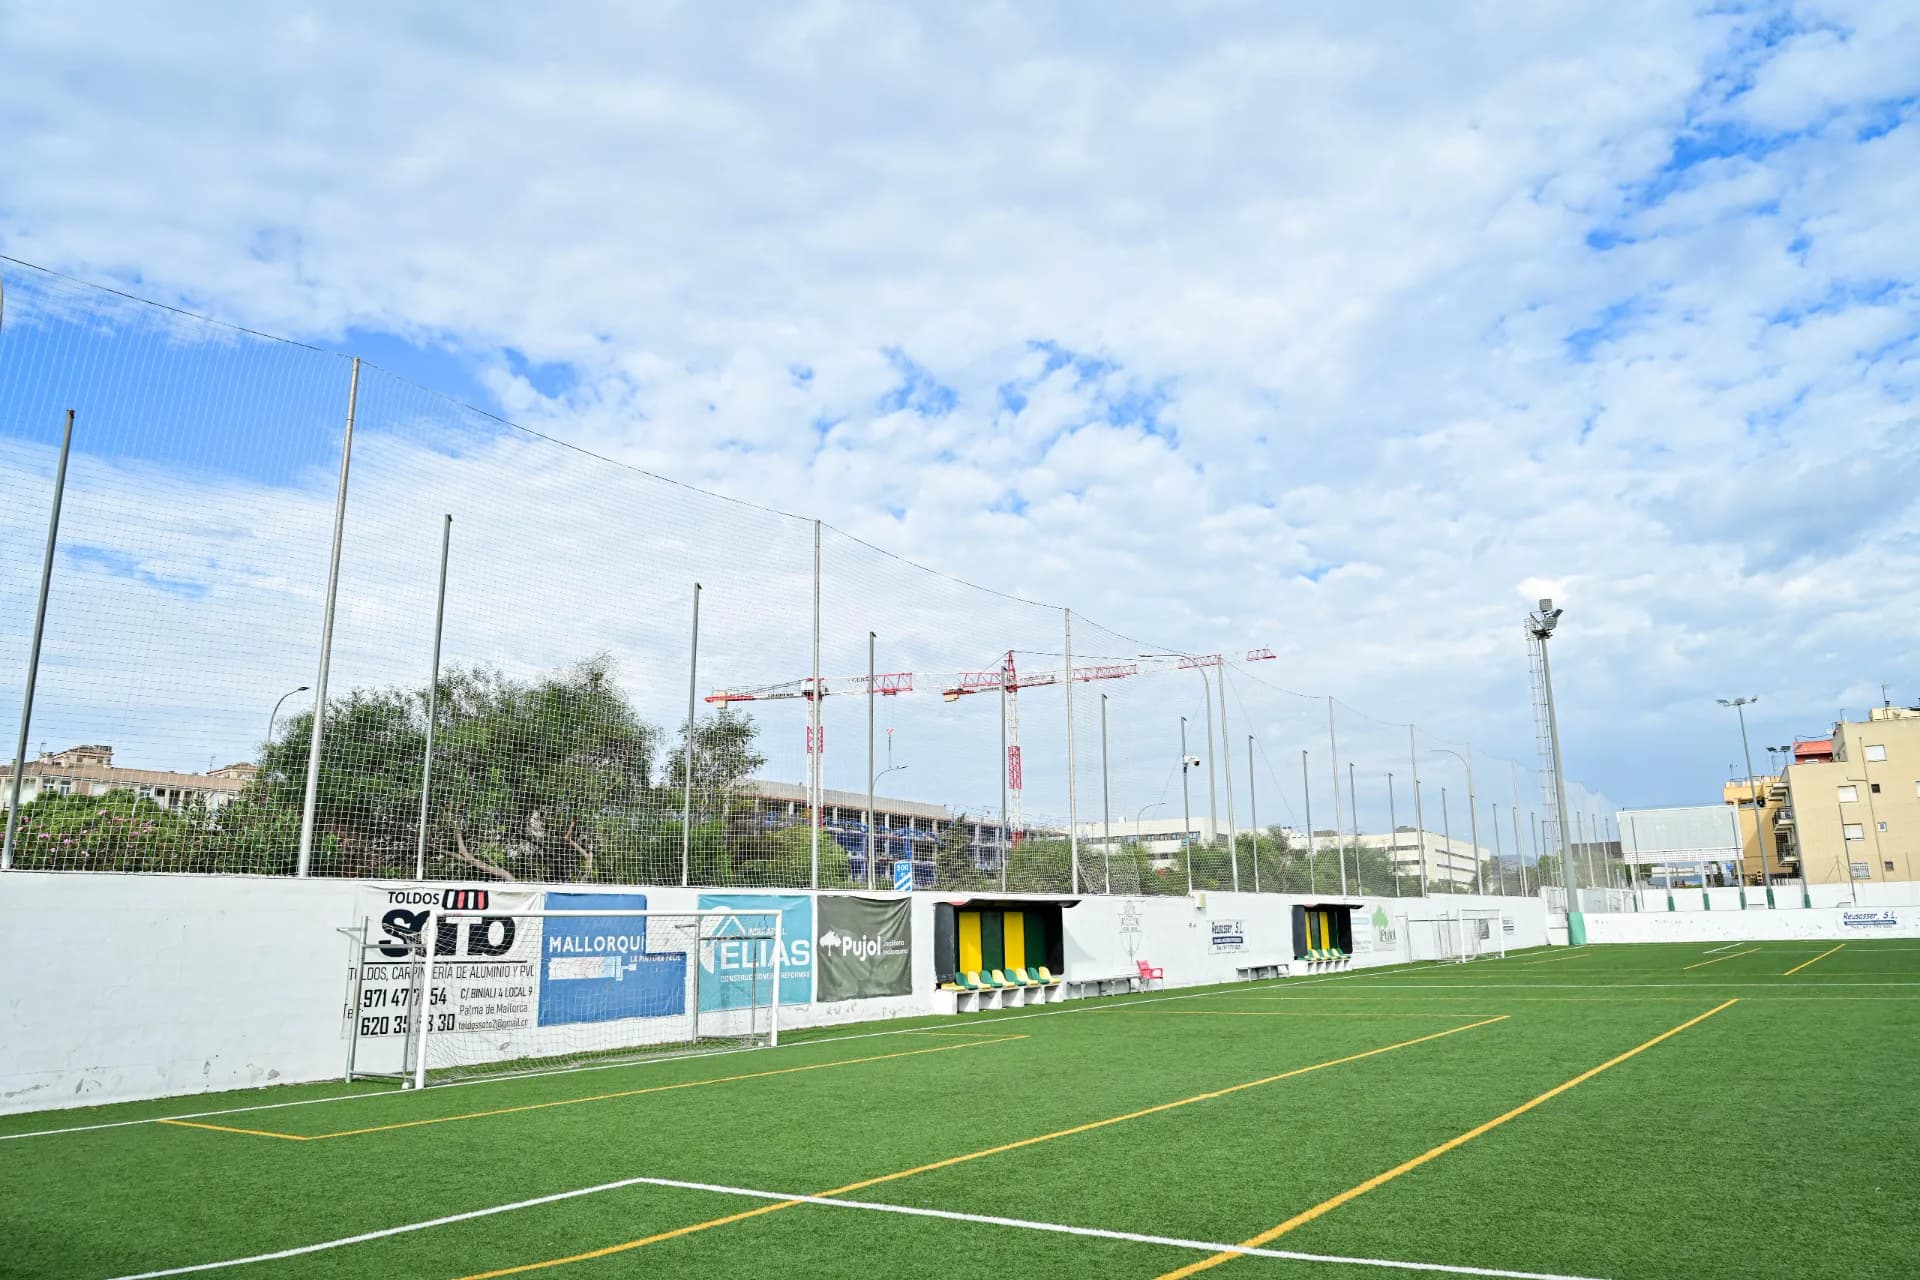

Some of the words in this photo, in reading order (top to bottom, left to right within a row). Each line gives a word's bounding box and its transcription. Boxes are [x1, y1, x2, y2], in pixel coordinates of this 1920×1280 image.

[388, 891, 440, 904] TOLDOS
[720, 939, 810, 969] ELIAS
[842, 934, 880, 962] Pujol
[456, 966, 467, 979] DE
[469, 965, 511, 979] ALUMINIO
[513, 965, 519, 977] Y
[363, 989, 387, 1007] 971
[391, 988, 410, 1007] 47
[430, 987, 447, 1005] 54
[505, 986, 527, 998] LOCAL
[459, 1004, 483, 1016] Palma
[485, 1003, 495, 1015] de
[496, 1002, 528, 1014] Mallorca
[361, 1016, 389, 1036] 620
[437, 1013, 455, 1032] 30
